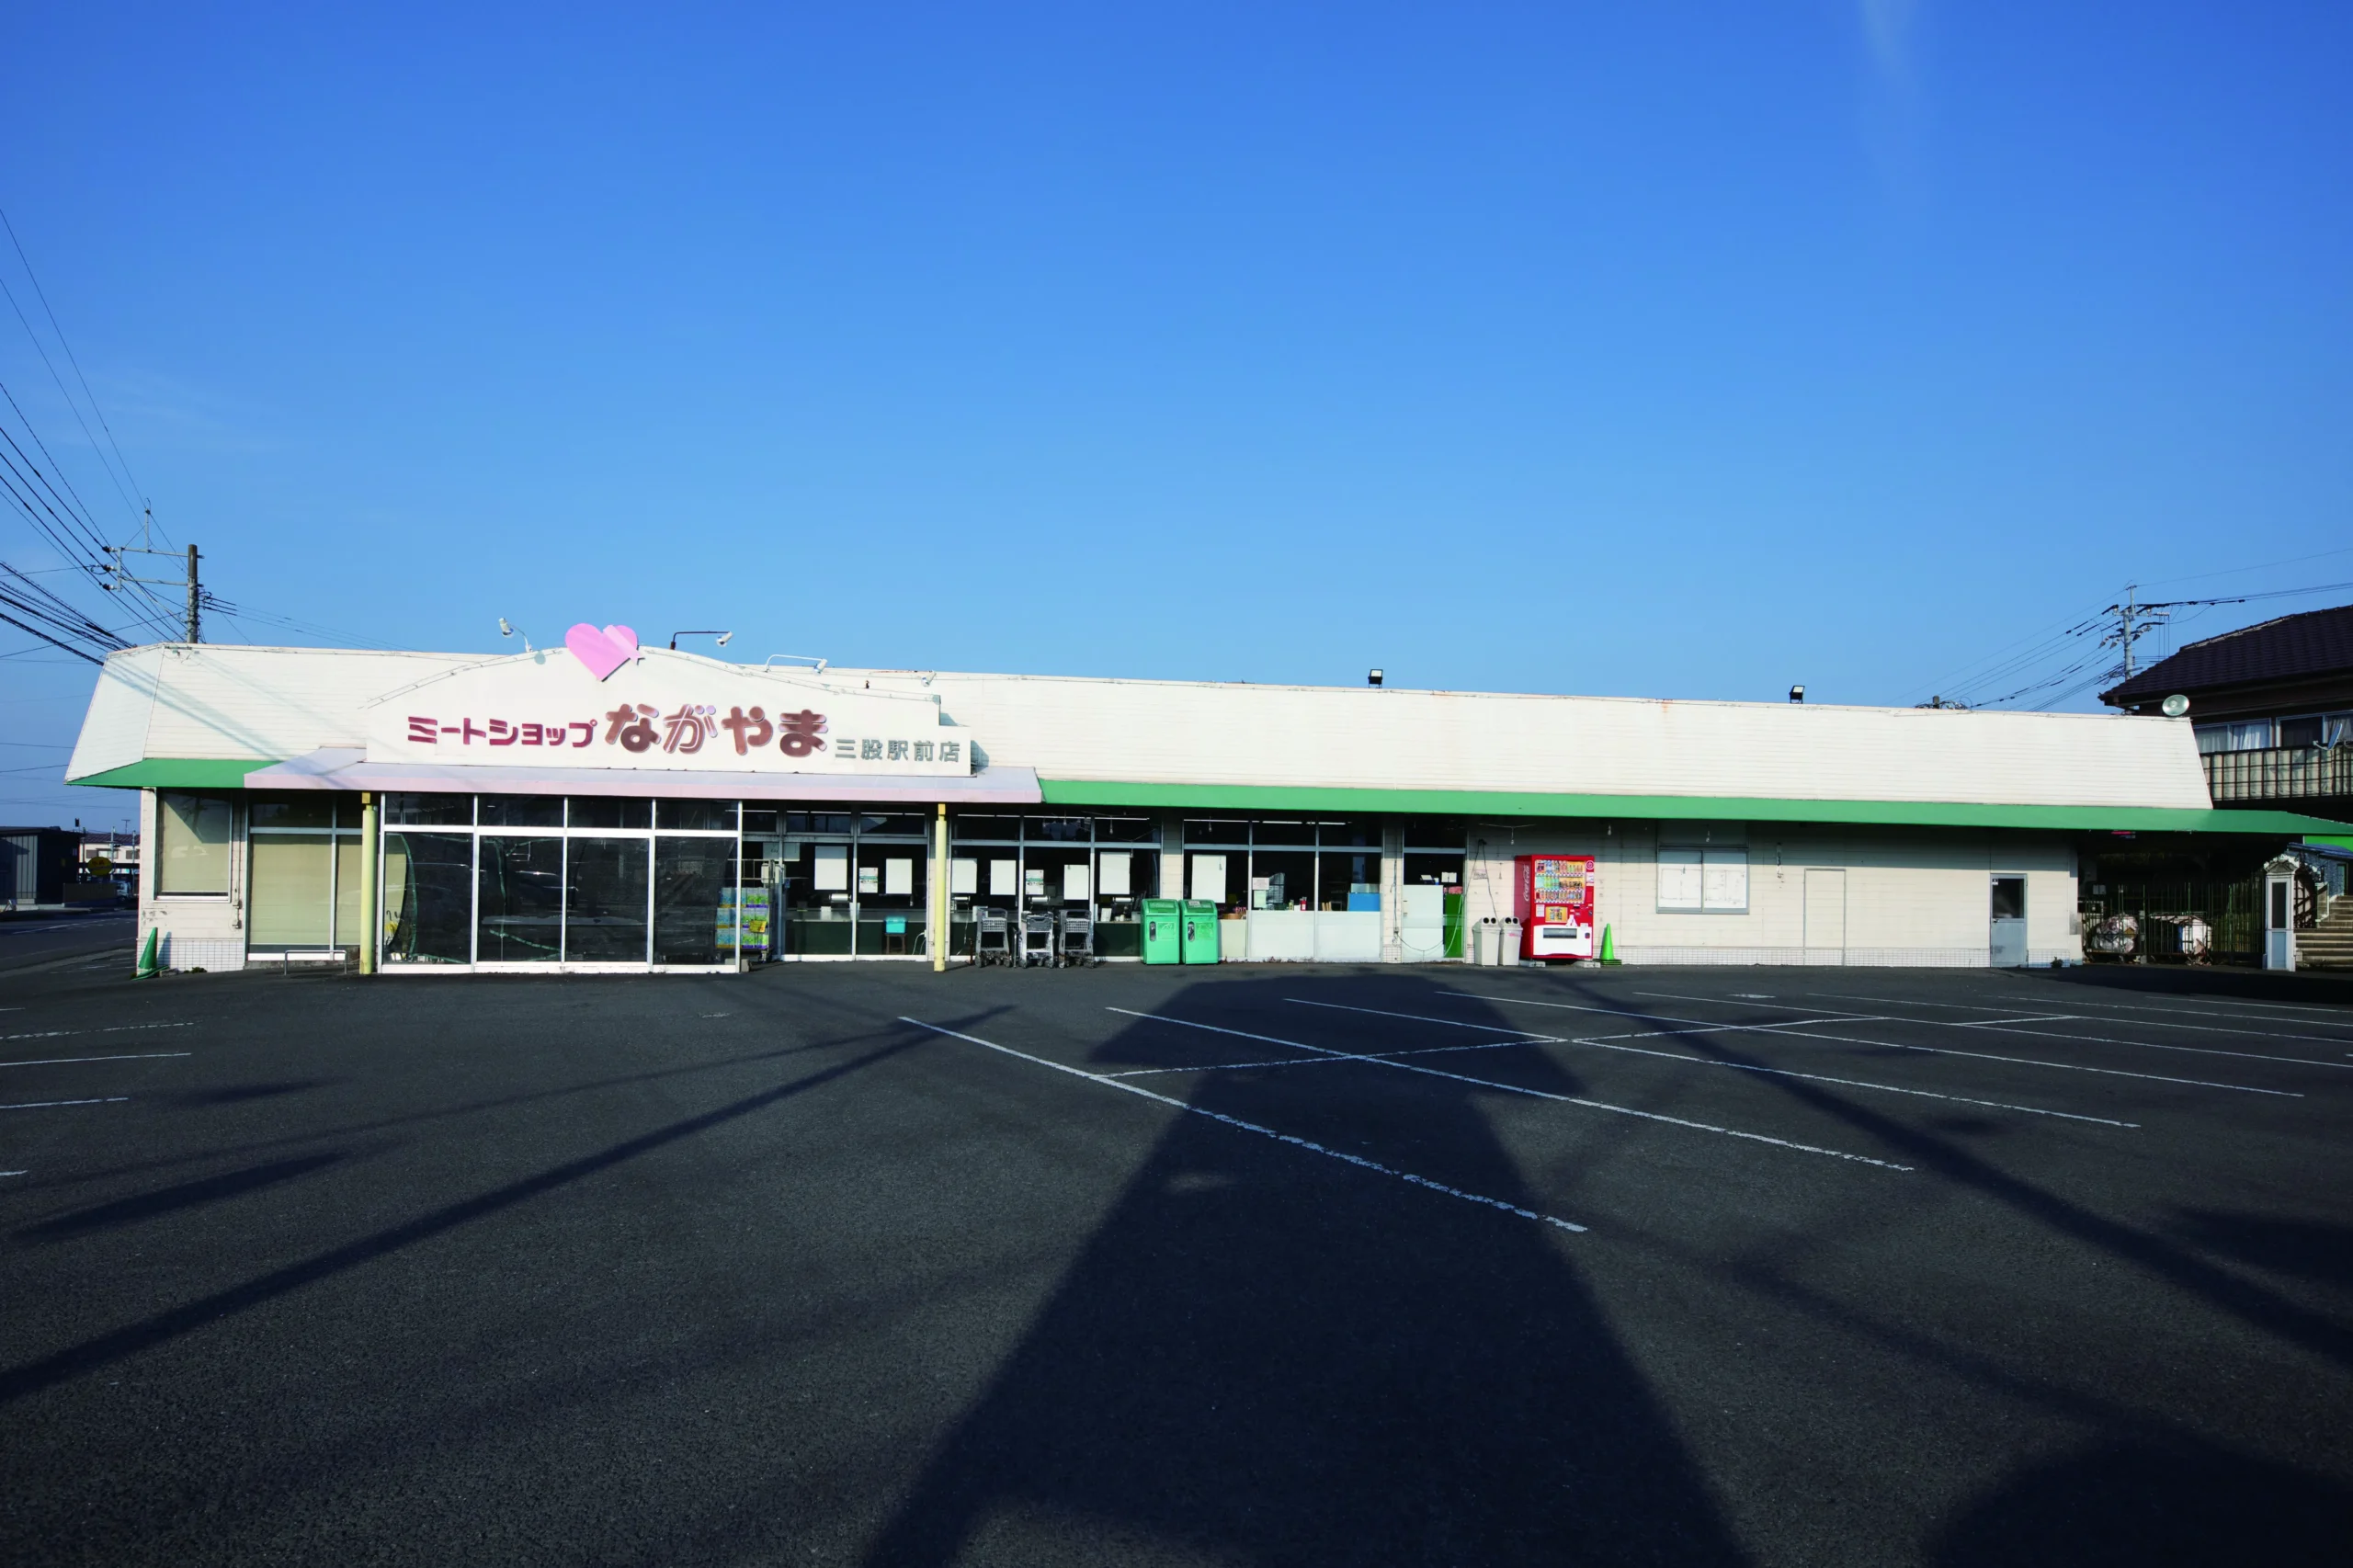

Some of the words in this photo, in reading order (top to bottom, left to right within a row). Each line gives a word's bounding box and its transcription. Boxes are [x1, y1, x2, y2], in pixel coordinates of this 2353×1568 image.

[408, 717, 597, 747] ミートショップ
[605, 703, 828, 757] ながやま
[835, 739, 961, 763] 三股駅前店
